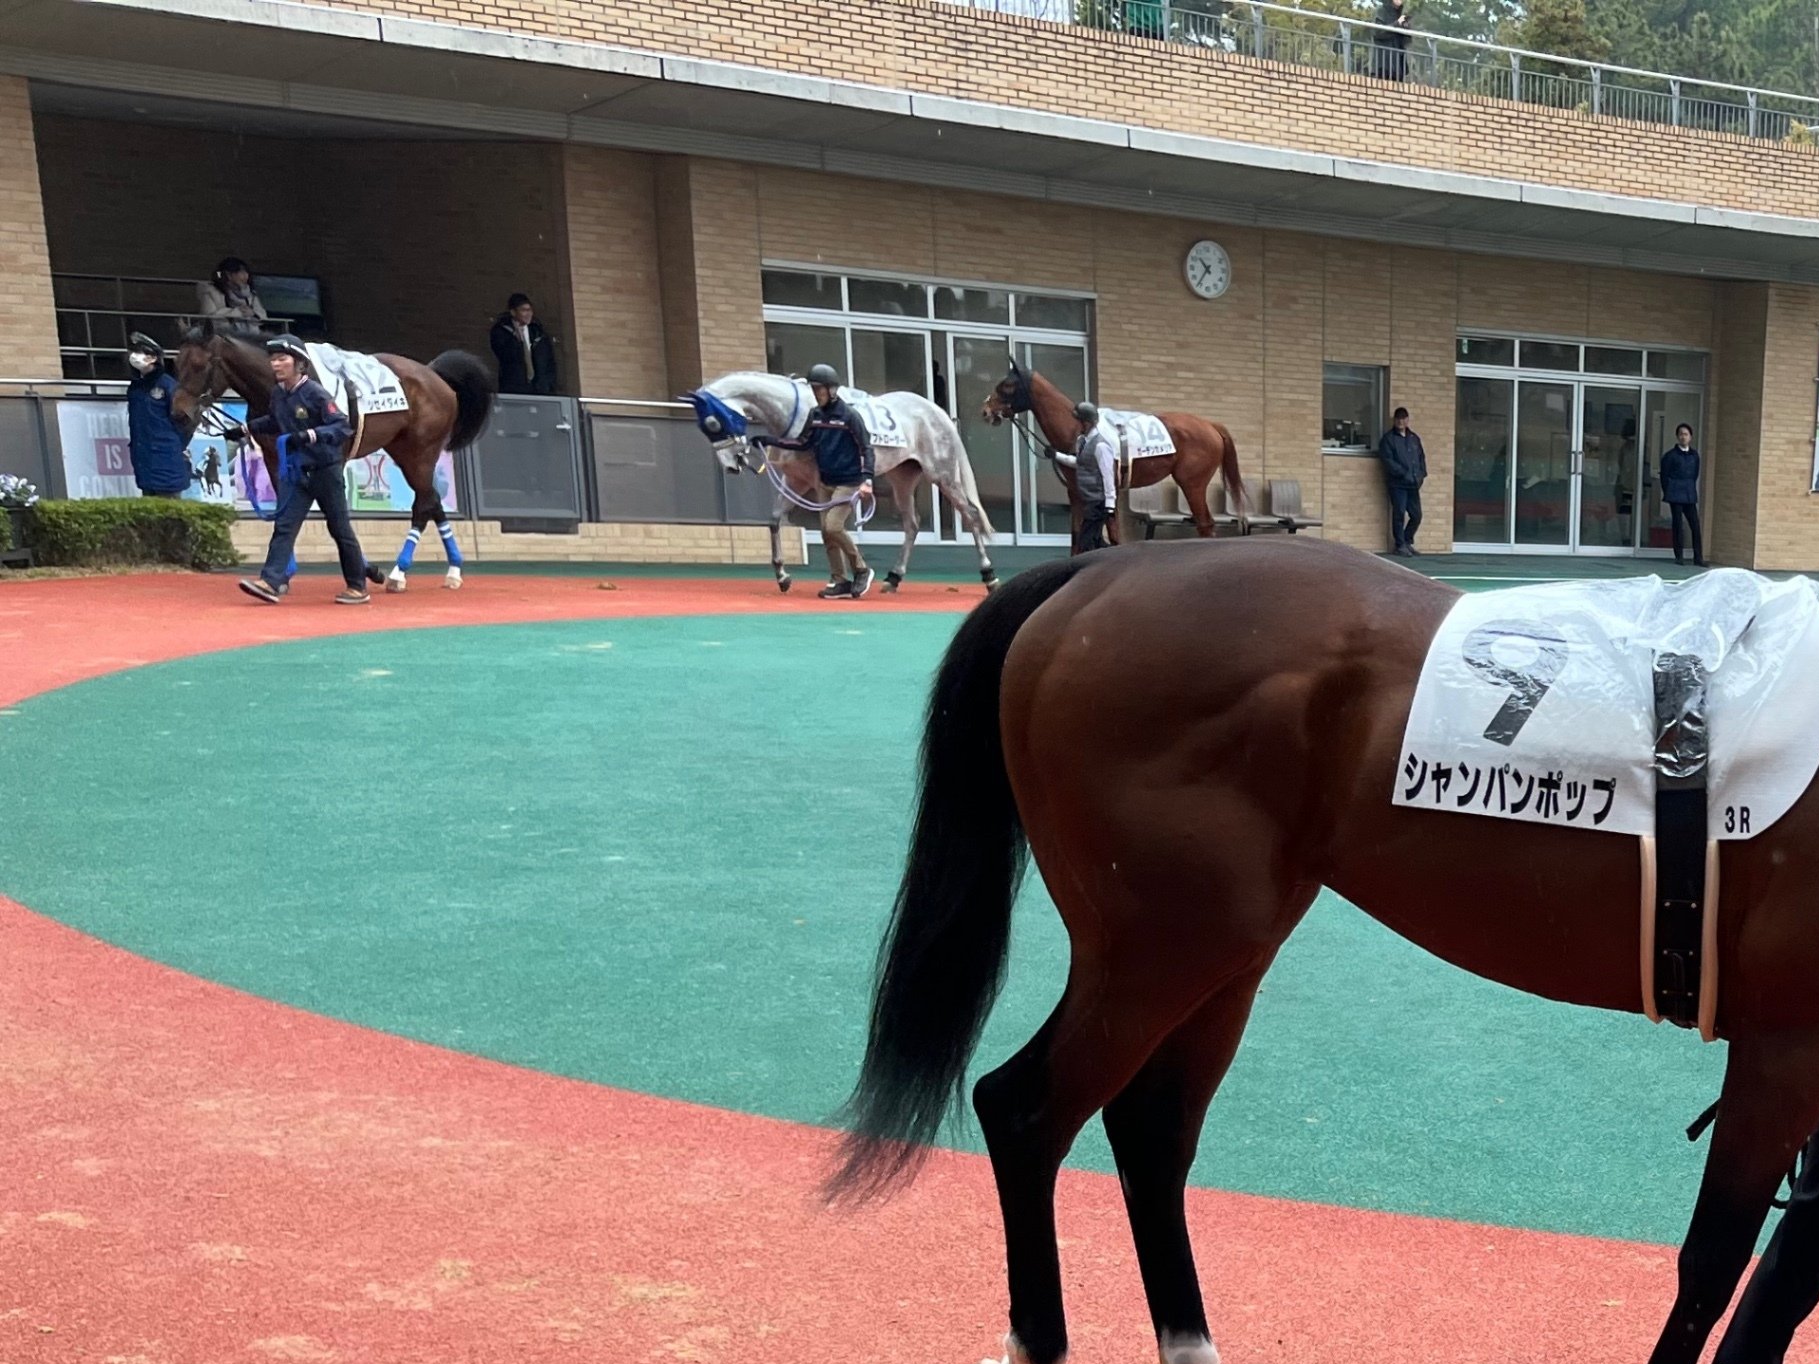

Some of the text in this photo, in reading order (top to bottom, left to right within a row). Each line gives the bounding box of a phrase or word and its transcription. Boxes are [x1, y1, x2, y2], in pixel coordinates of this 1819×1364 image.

[104, 444, 123, 470] IS
[1462, 618, 1569, 747] 9
[1403, 752, 1618, 826] シャンパンポップ
